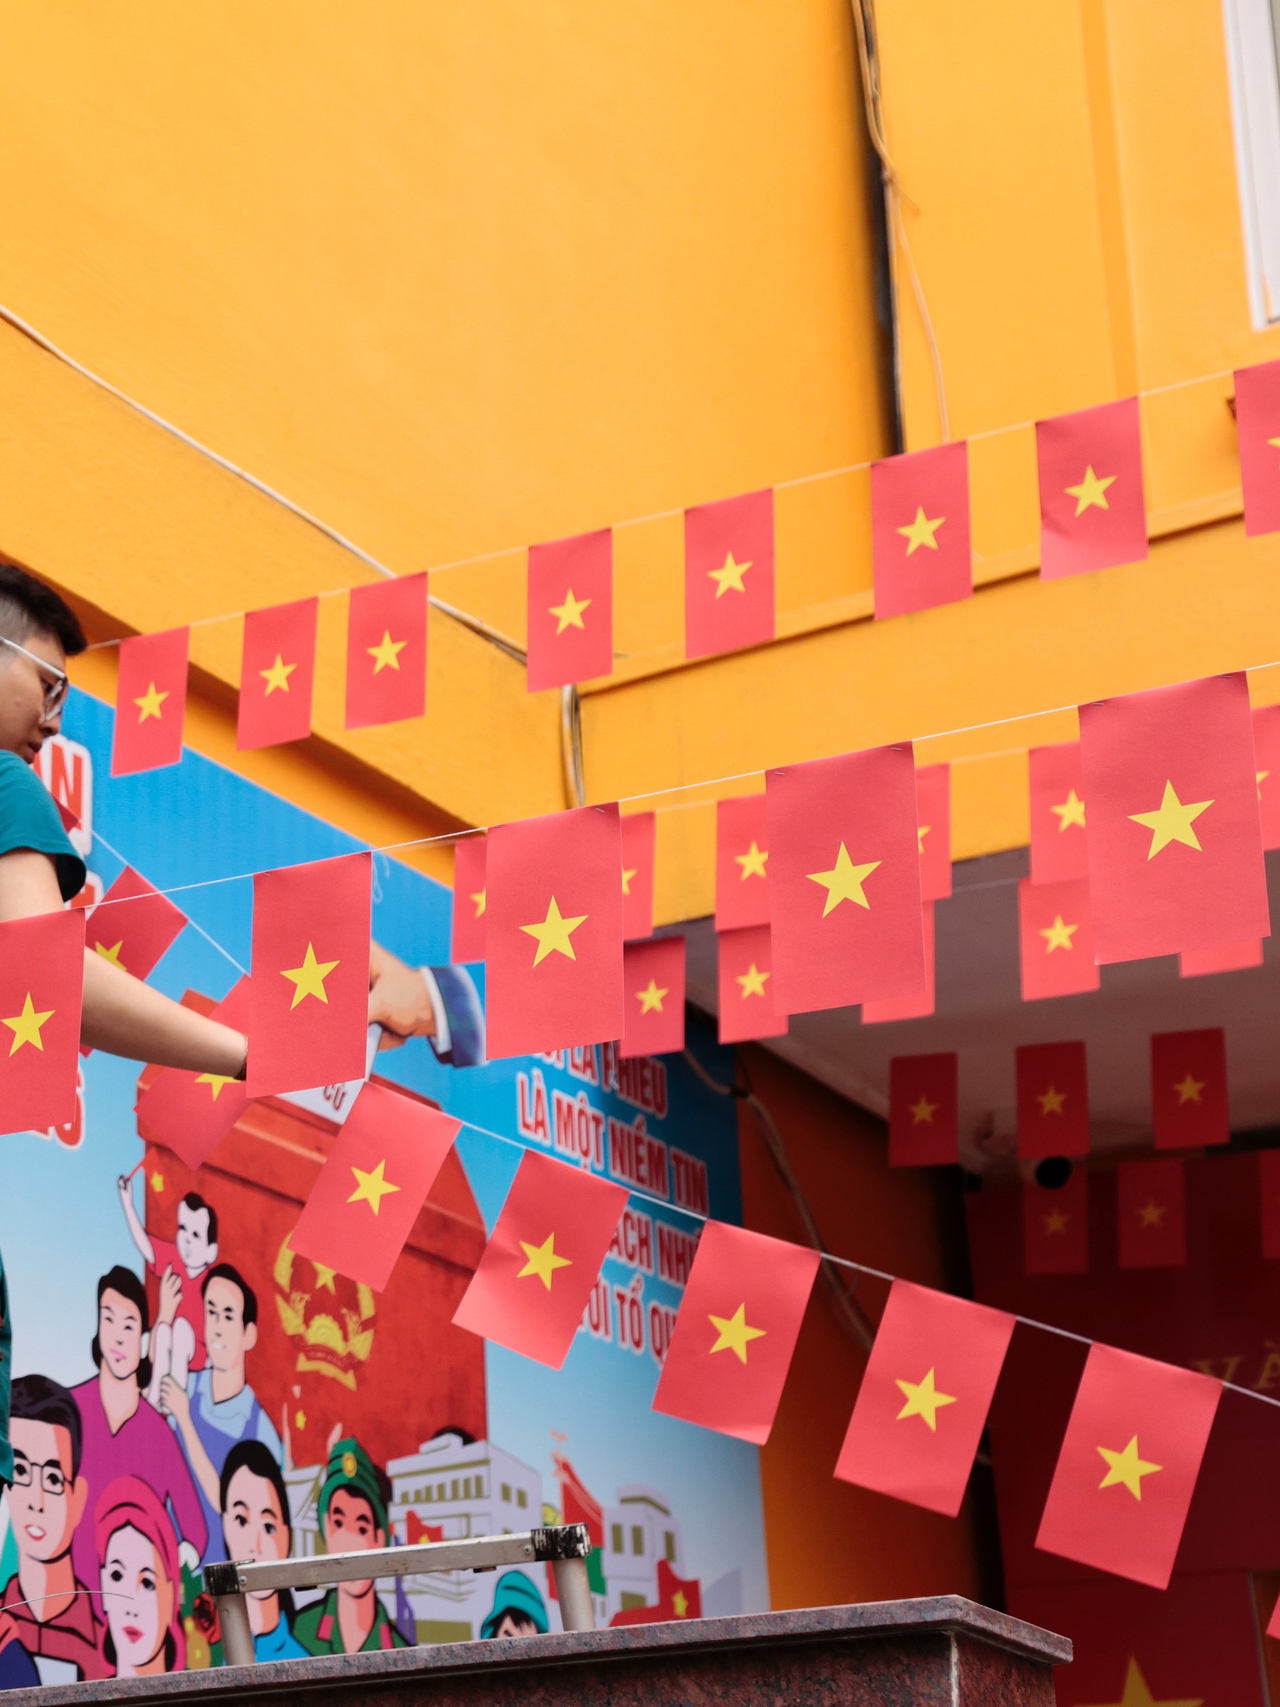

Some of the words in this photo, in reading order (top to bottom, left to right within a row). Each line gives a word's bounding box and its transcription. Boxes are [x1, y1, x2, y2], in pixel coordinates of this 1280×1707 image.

[520, 1074, 549, 1140] LÀ
[556, 1096, 604, 1170] MỘT
[671, 1152, 708, 1213] TIN
